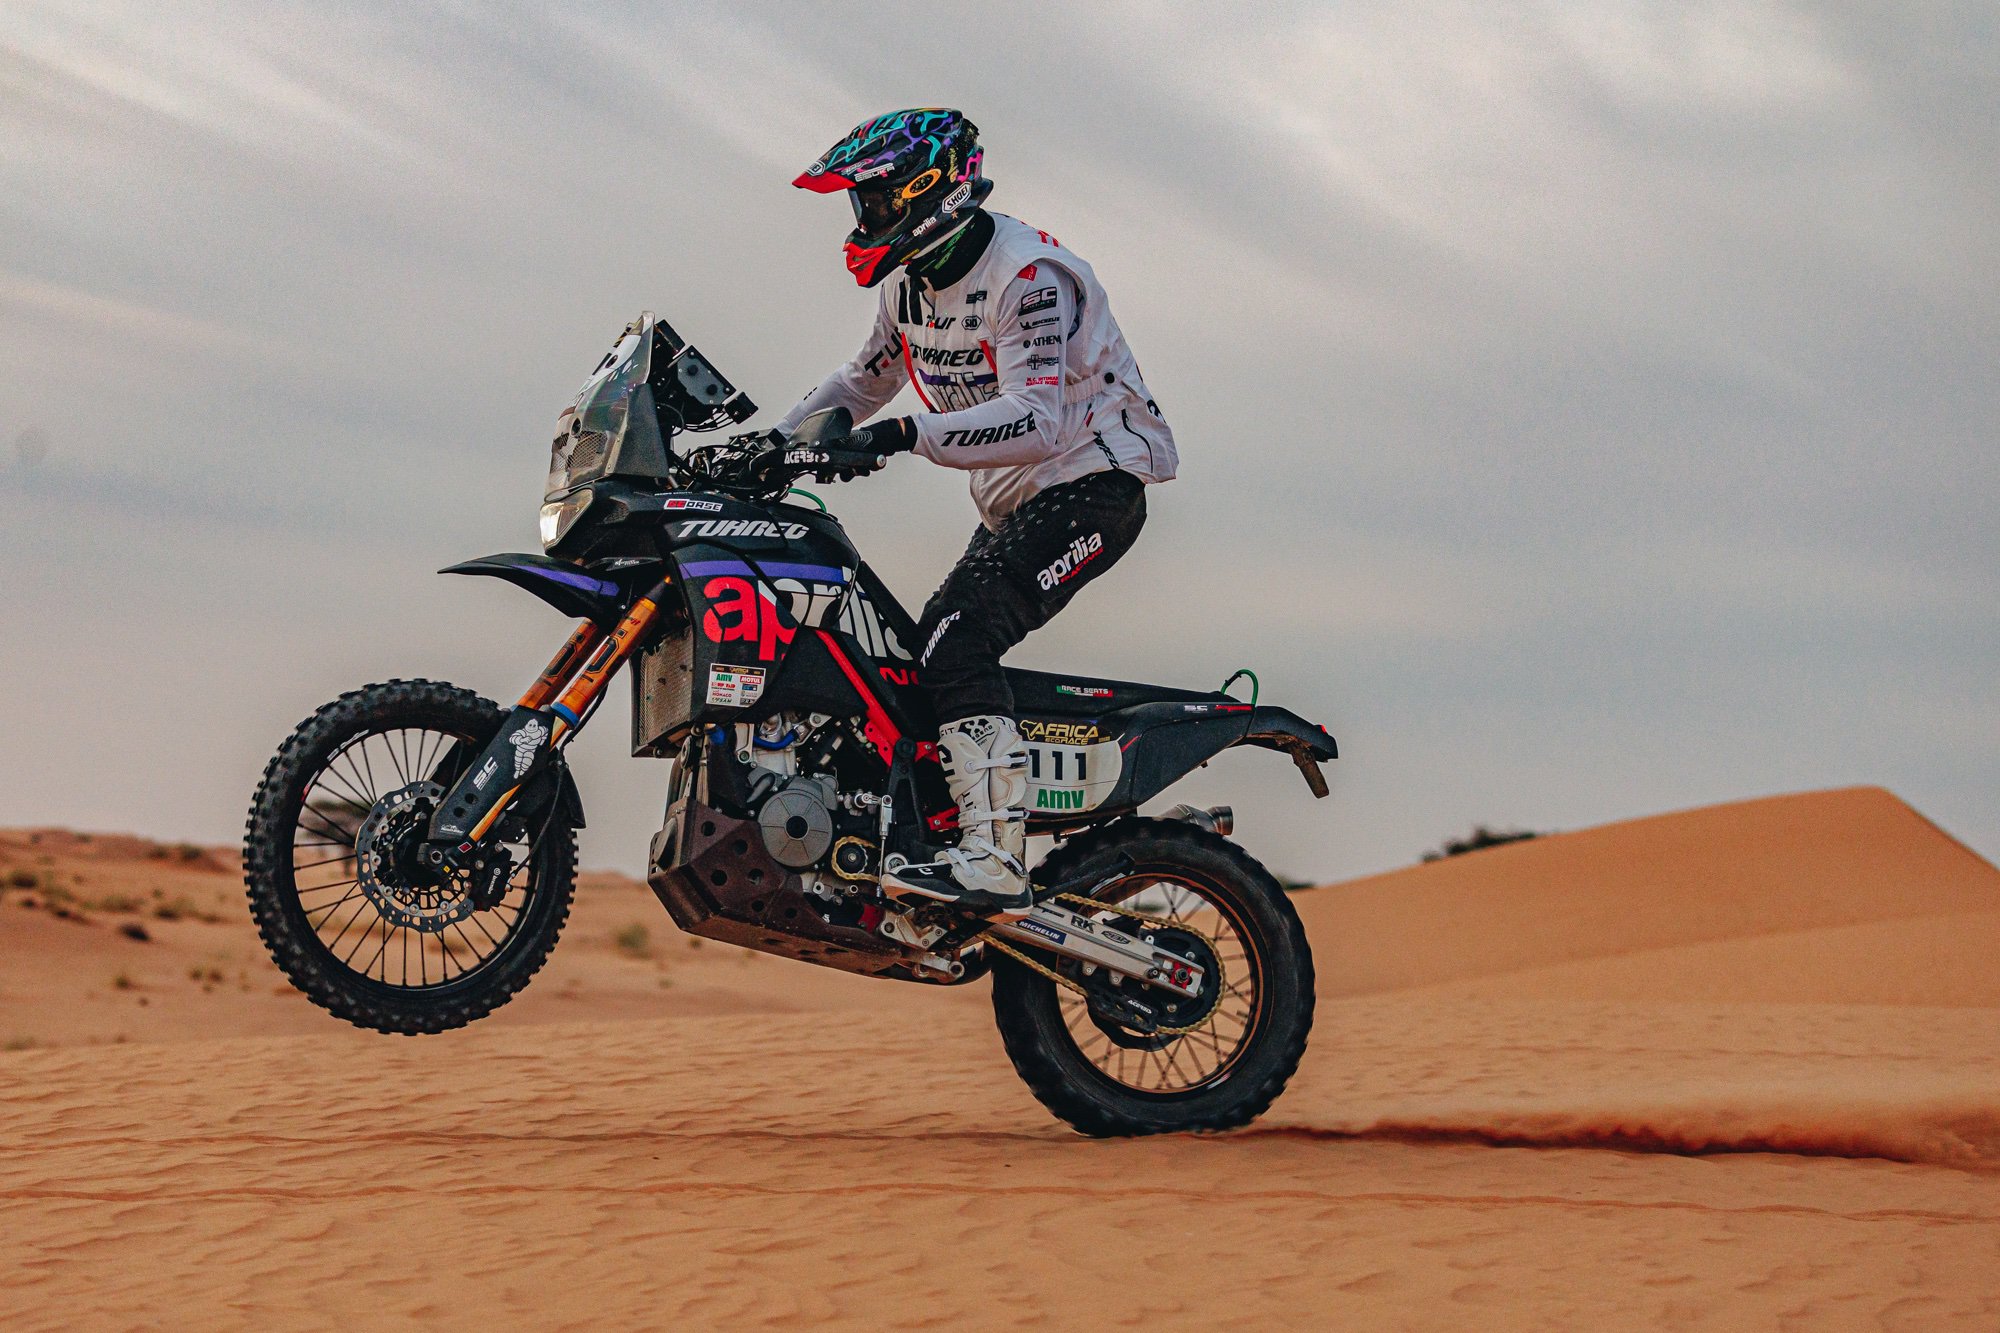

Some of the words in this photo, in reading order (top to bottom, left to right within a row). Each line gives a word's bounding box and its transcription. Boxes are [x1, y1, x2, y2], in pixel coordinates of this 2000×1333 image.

[946, 186, 968, 209] SHOEI
[912, 216, 937, 237] aprilia
[677, 520, 810, 540] TUAREG
[1036, 532, 1103, 591] aprilia
[1061, 685, 1081, 693] RACE
[1029, 722, 1099, 739] AFRICA
[1029, 749, 1087, 781] 111
[1018, 920, 1061, 941] MICHELIN
[1071, 915, 1096, 935] RK
